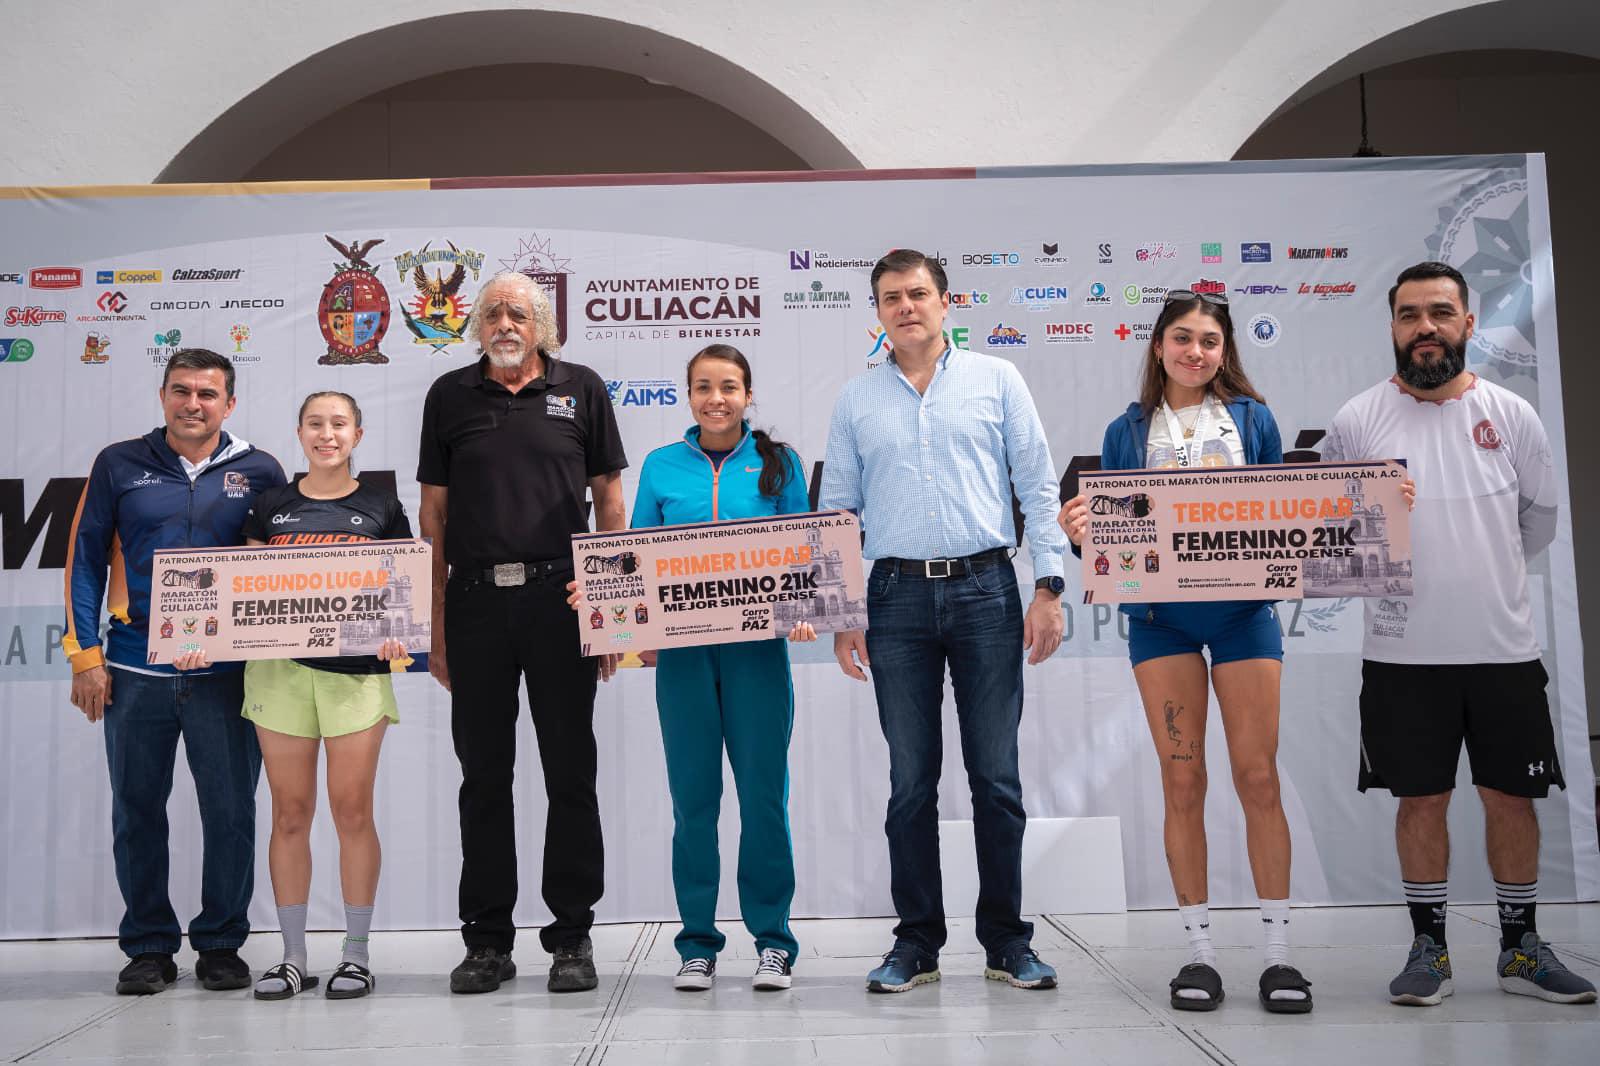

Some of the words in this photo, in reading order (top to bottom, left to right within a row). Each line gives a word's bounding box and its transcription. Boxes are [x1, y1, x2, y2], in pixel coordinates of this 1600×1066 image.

[963, 254, 1019, 265] BOSETO
[35, 272, 77, 281] Panamá
[119, 271, 157, 283] Coppel
[172, 267, 241, 281] CalzzaSport
[585, 277, 729, 293] AYUNTAMIENTO
[735, 276, 760, 290] DE
[1142, 287, 1168, 296] Godoy
[150, 301, 210, 311] OMODA
[585, 292, 761, 322] CULIACÁN
[6, 307, 66, 326] SuKarne
[76, 314, 147, 322] ARCACONTINENTAL
[585, 329, 644, 341] CAPITAL
[652, 328, 670, 340] DE
[679, 328, 761, 339] BIENESTAR
[1046, 323, 1094, 335] IMDEC
[622, 388, 678, 406] AIMS
[1086, 479, 1147, 489] PATRONATO
[1149, 479, 1166, 487] DEL
[1168, 475, 1220, 486] MARATÓN
[1221, 473, 1304, 485] INTERNACIONAL
[1306, 472, 1319, 481] DE
[1321, 469, 1377, 480] CULIACÁN,
[1380, 469, 1401, 478] A.C.
[1173, 499, 1264, 523] TERCER
[1269, 497, 1353, 521] LUGAR
[1091, 519, 1156, 529] MARATÓN
[578, 539, 634, 551] PATRONATO
[653, 532, 698, 544] MARATÓN
[699, 527, 770, 539] INTERNACIONAL
[772, 524, 784, 532] DE
[785, 520, 834, 531] CULIACÁN,
[835, 518, 854, 526] A.C.
[1092, 533, 1158, 545] CULIACÁN
[1172, 529, 1307, 551] FEMENINO
[1312, 527, 1356, 547] 21K
[159, 556, 213, 565] PATRONATO
[215, 555, 230, 563] DEL
[231, 552, 276, 562] MARATÓN
[277, 550, 347, 560] INTERNACIONAL
[361, 547, 408, 556] CULIACÁN,
[410, 546, 427, 554] A.C.
[656, 553, 736, 577] PRIMER
[740, 545, 812, 570] LUGAR
[1177, 551, 1239, 562] MEJOR
[1242, 548, 1355, 561] SINALOENSE
[1266, 564, 1298, 573] Corro
[232, 573, 322, 593] SEGUNDO
[329, 569, 389, 590] LUGAR
[585, 575, 643, 587] MARATÓN
[586, 582, 645, 592] INTERNACIONAL
[658, 576, 776, 602] FEMENINO
[780, 571, 818, 591] 21K
[1264, 577, 1297, 588] PAZ
[160, 590, 218, 599] MARATÓN
[586, 588, 646, 602] CULIACÁN
[232, 596, 347, 618] FEMENINO
[351, 594, 388, 612] 21K
[663, 600, 718, 613] MEJOR
[720, 590, 817, 608] SINALOENSE
[160, 603, 218, 613] CULIACÁN
[742, 608, 770, 617] Corro
[233, 616, 287, 626] MEJOR
[289, 612, 385, 624] SINALOENSE
[309, 626, 336, 634] Corro
[741, 620, 769, 631] PAZ
[306, 637, 335, 648] PAZ
